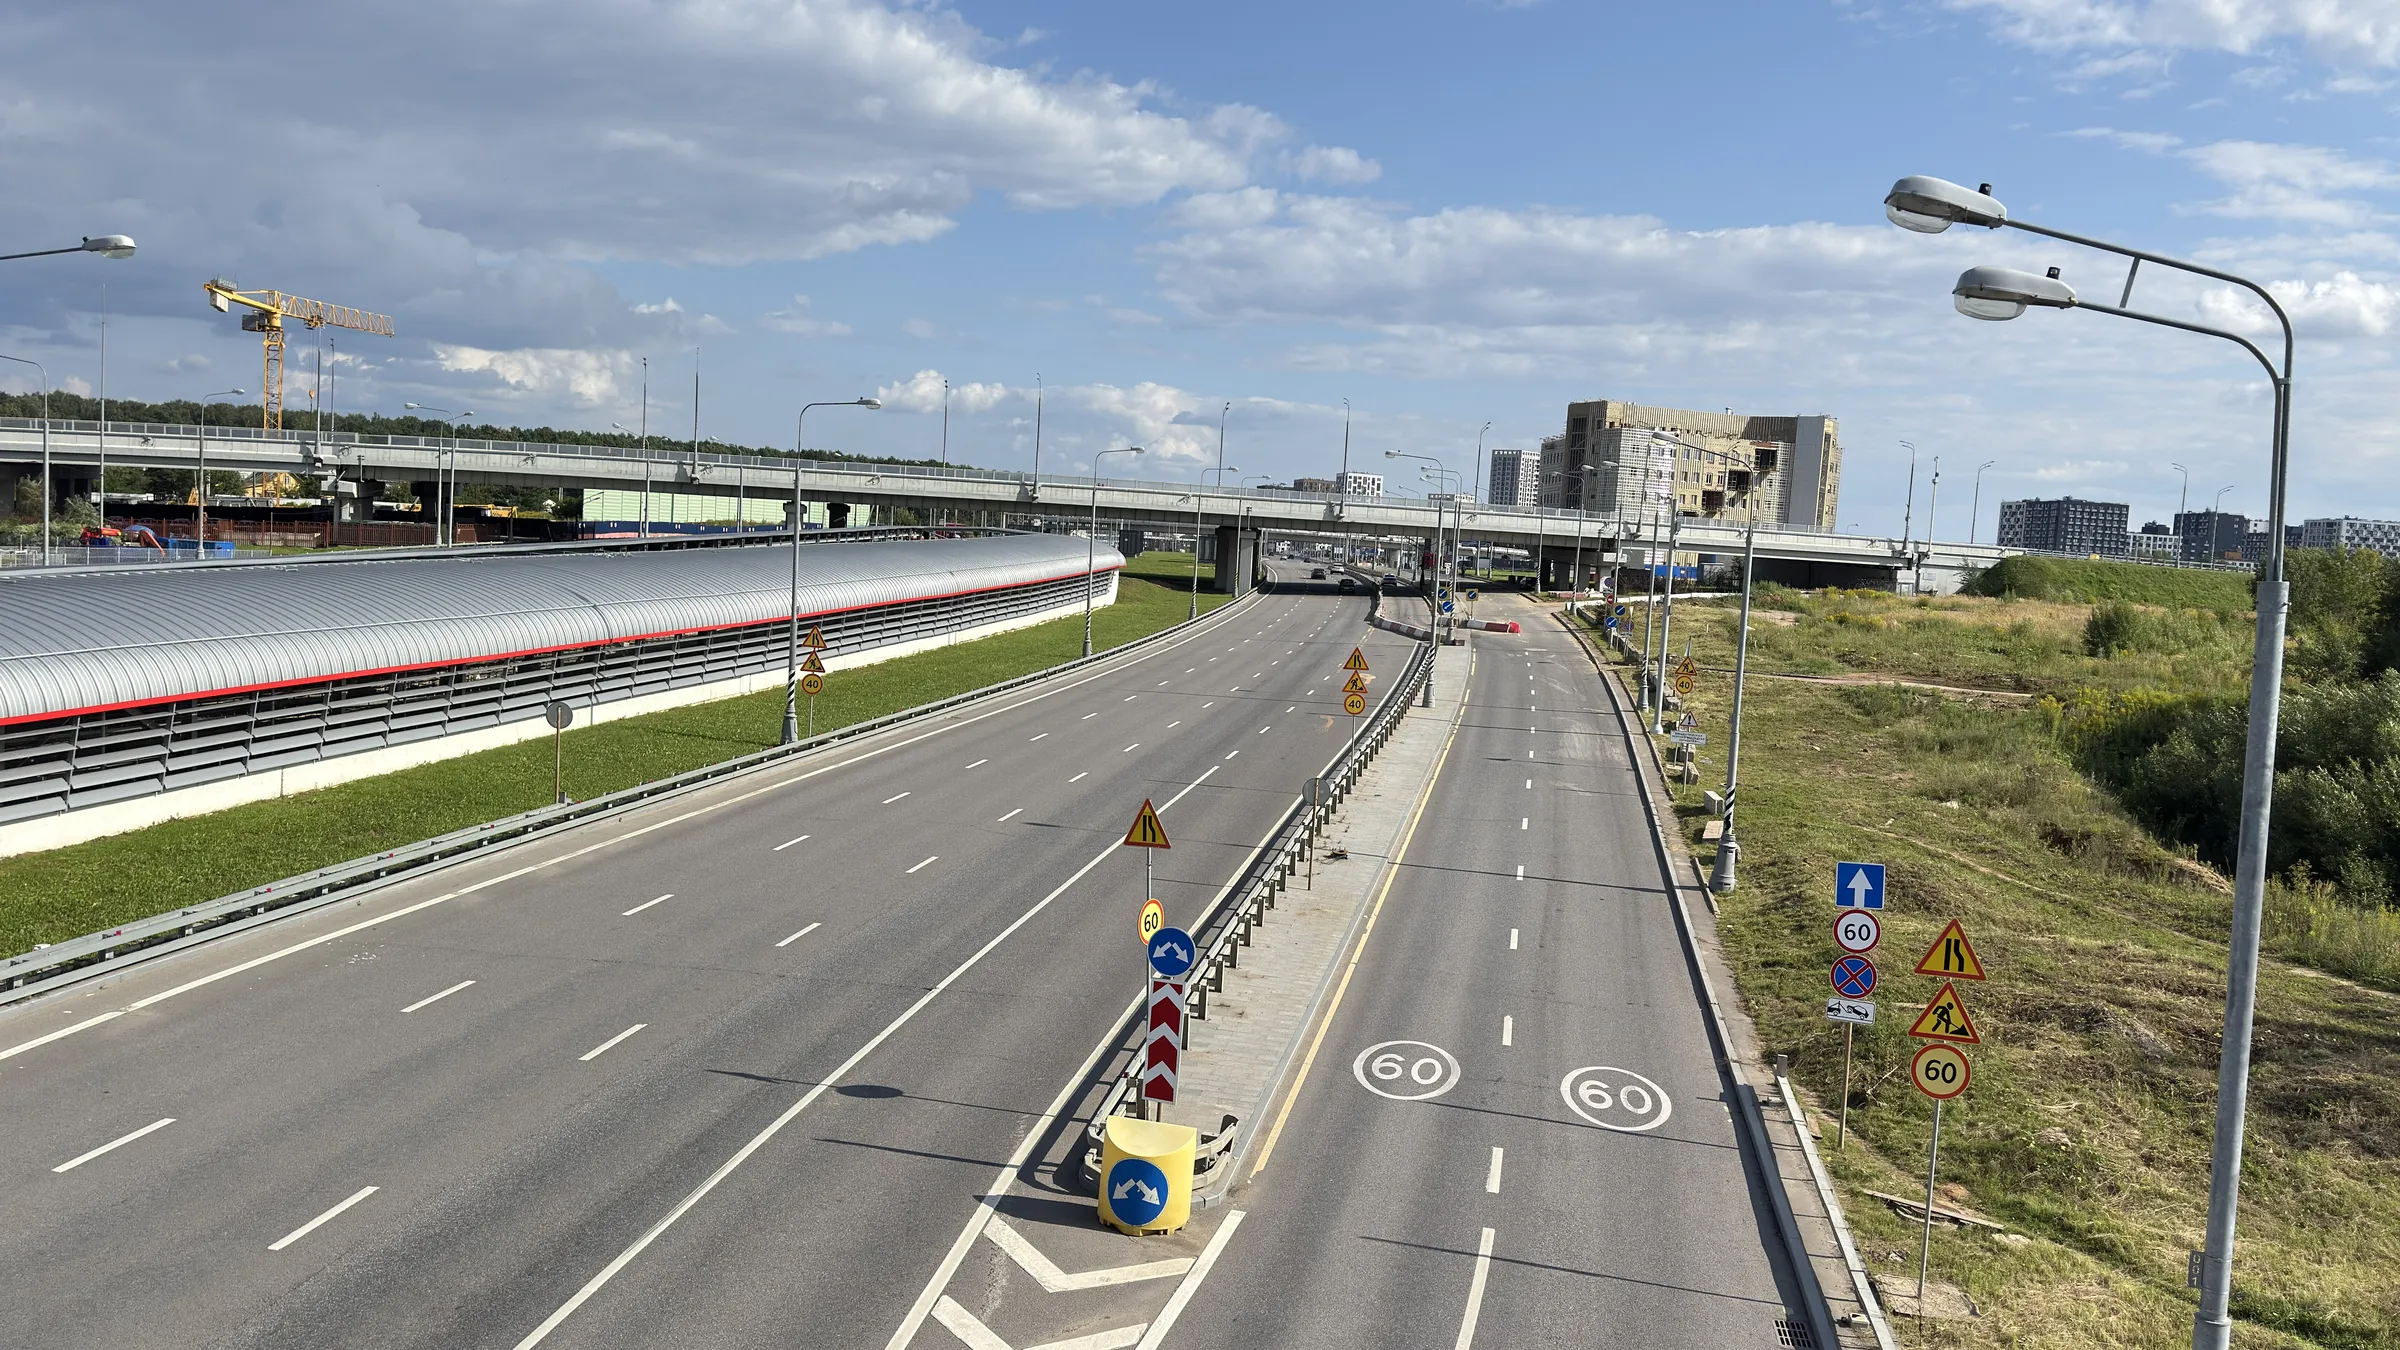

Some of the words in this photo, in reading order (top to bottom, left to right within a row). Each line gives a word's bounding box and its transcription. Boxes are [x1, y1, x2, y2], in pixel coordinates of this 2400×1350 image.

[806, 680, 819, 688] 40
[1679, 681, 1690, 689] 40
[1348, 700, 1361, 709] 40
[1144, 912, 1158, 932] 60
[1844, 923, 1871, 942] 60
[1371, 1053, 1442, 1085] 60
[1924, 1059, 1957, 1084] 60
[1578, 1080, 1652, 1115] 60
